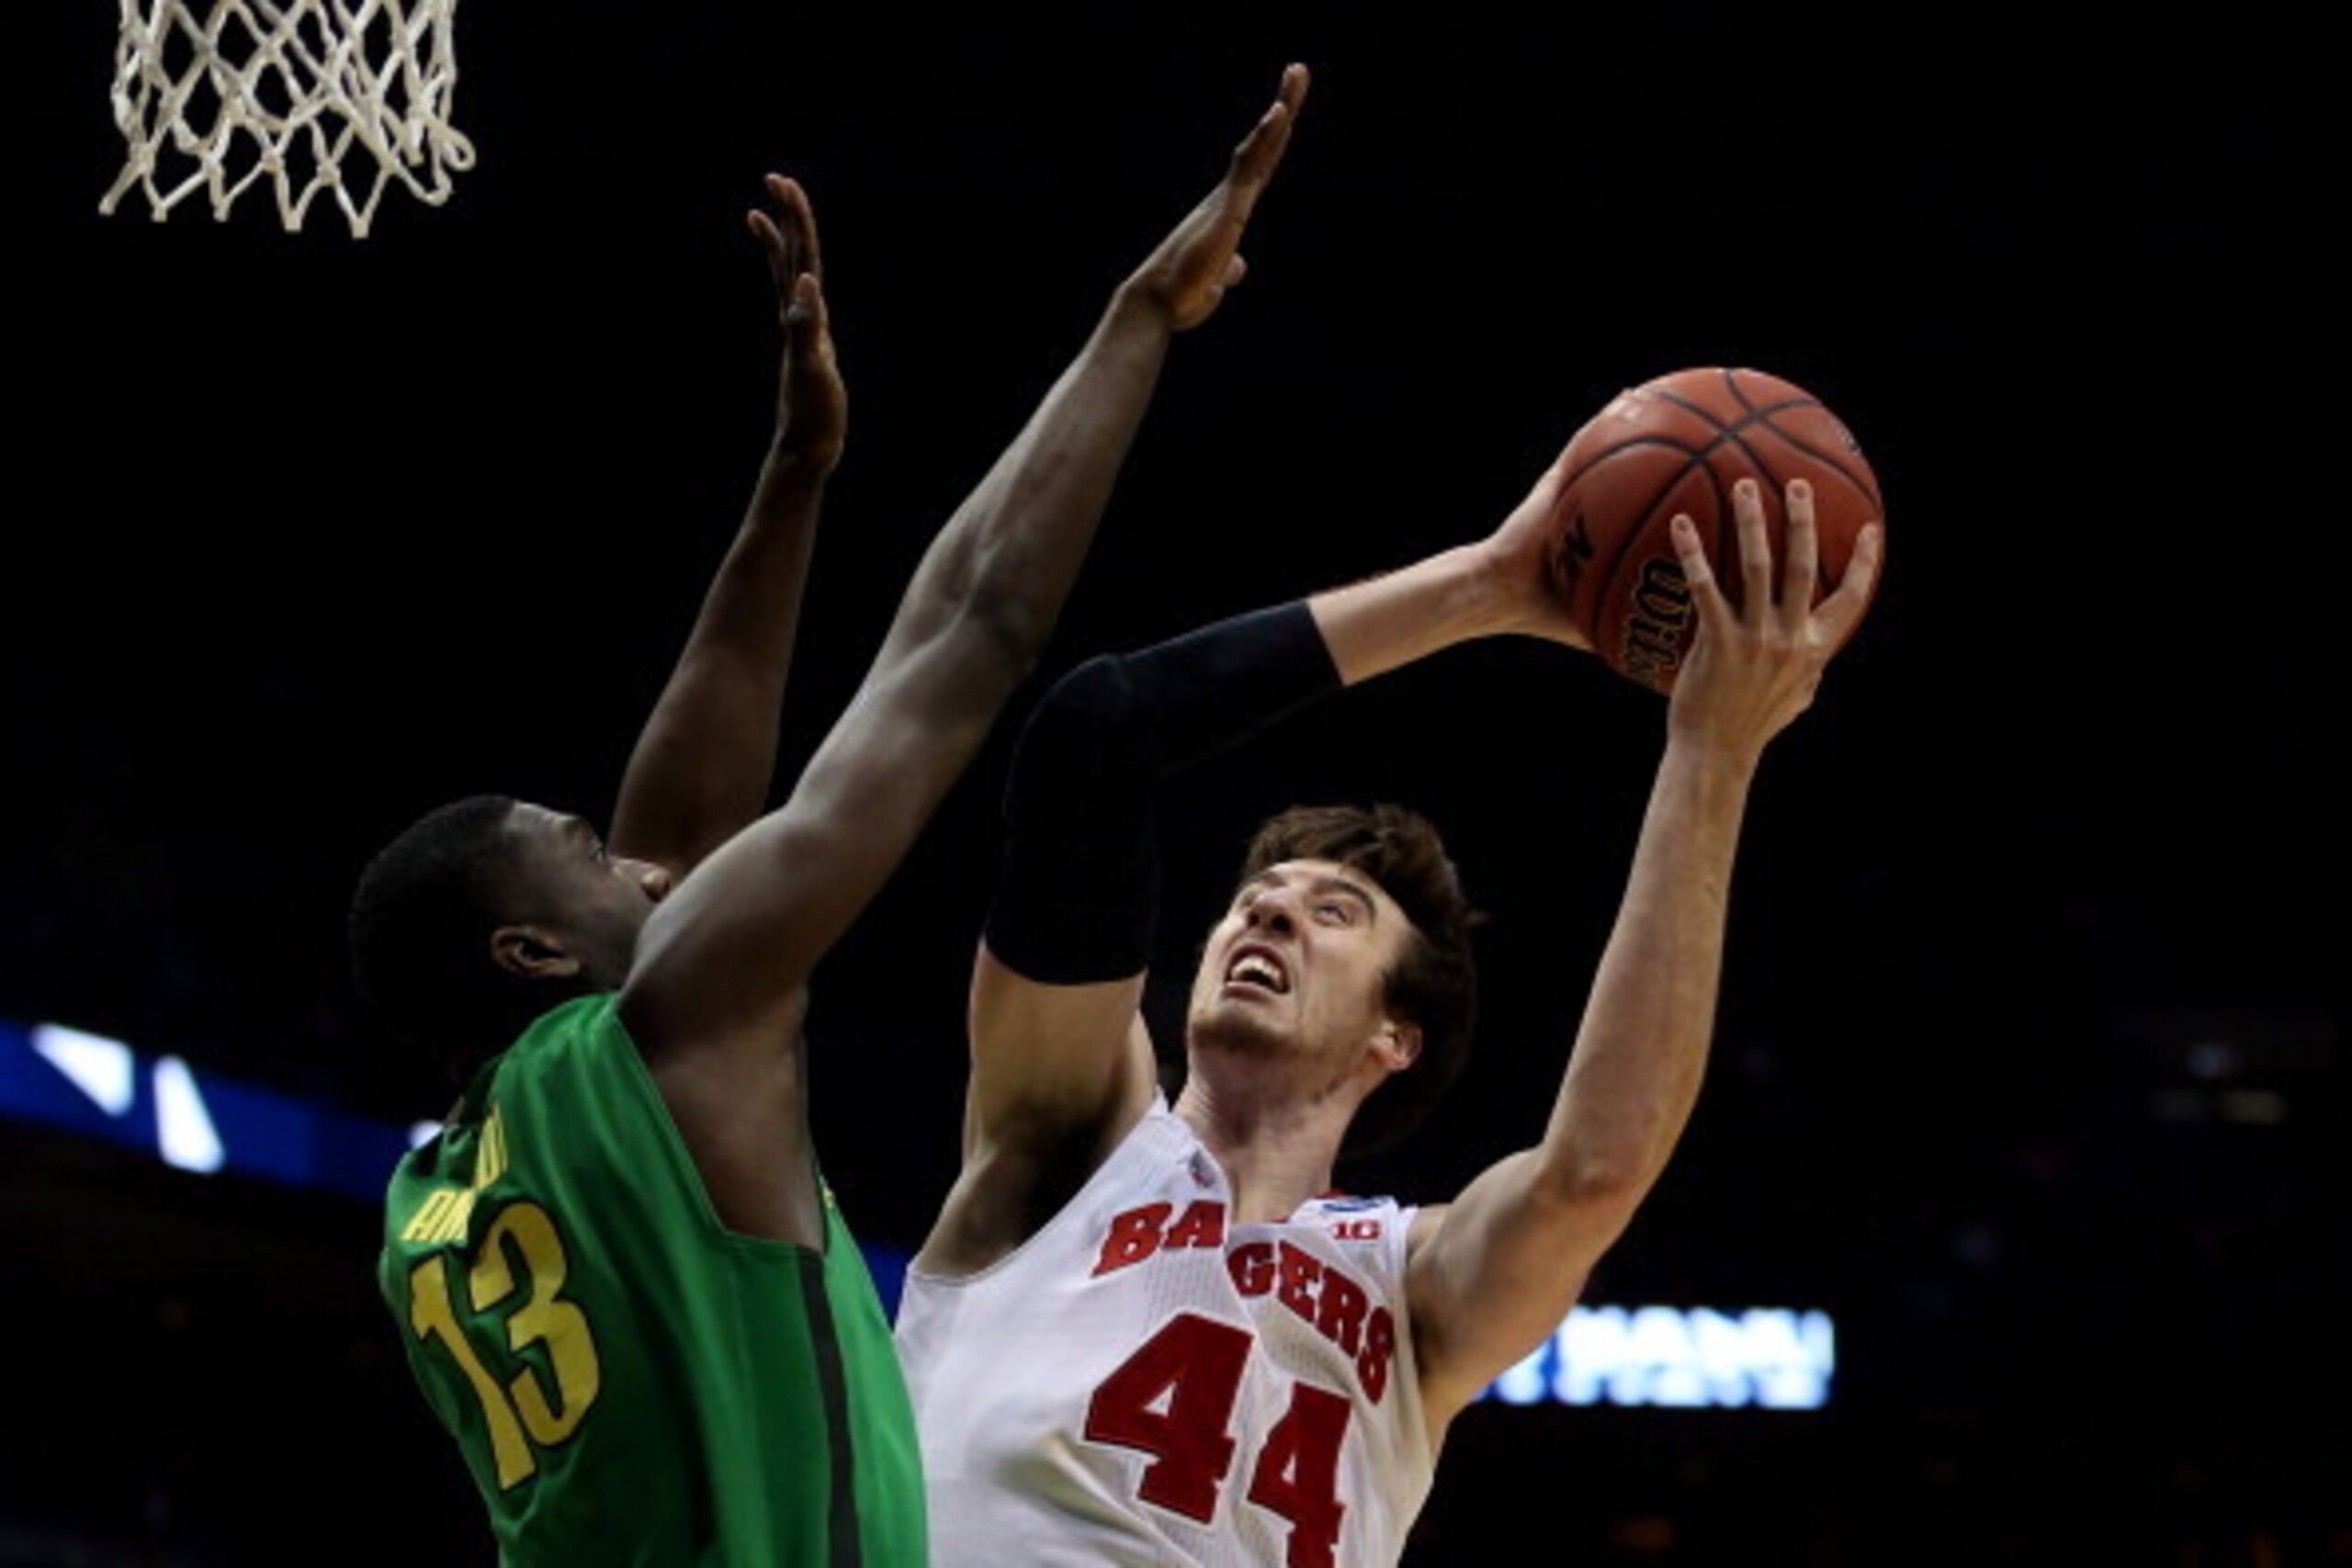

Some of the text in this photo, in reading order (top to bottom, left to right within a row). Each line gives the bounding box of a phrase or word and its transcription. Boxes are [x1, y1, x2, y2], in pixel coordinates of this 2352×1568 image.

[408, 1200, 601, 1492] 13
[1091, 1200, 1394, 1405] BAGERS
[1084, 1314, 1353, 1568] 44
